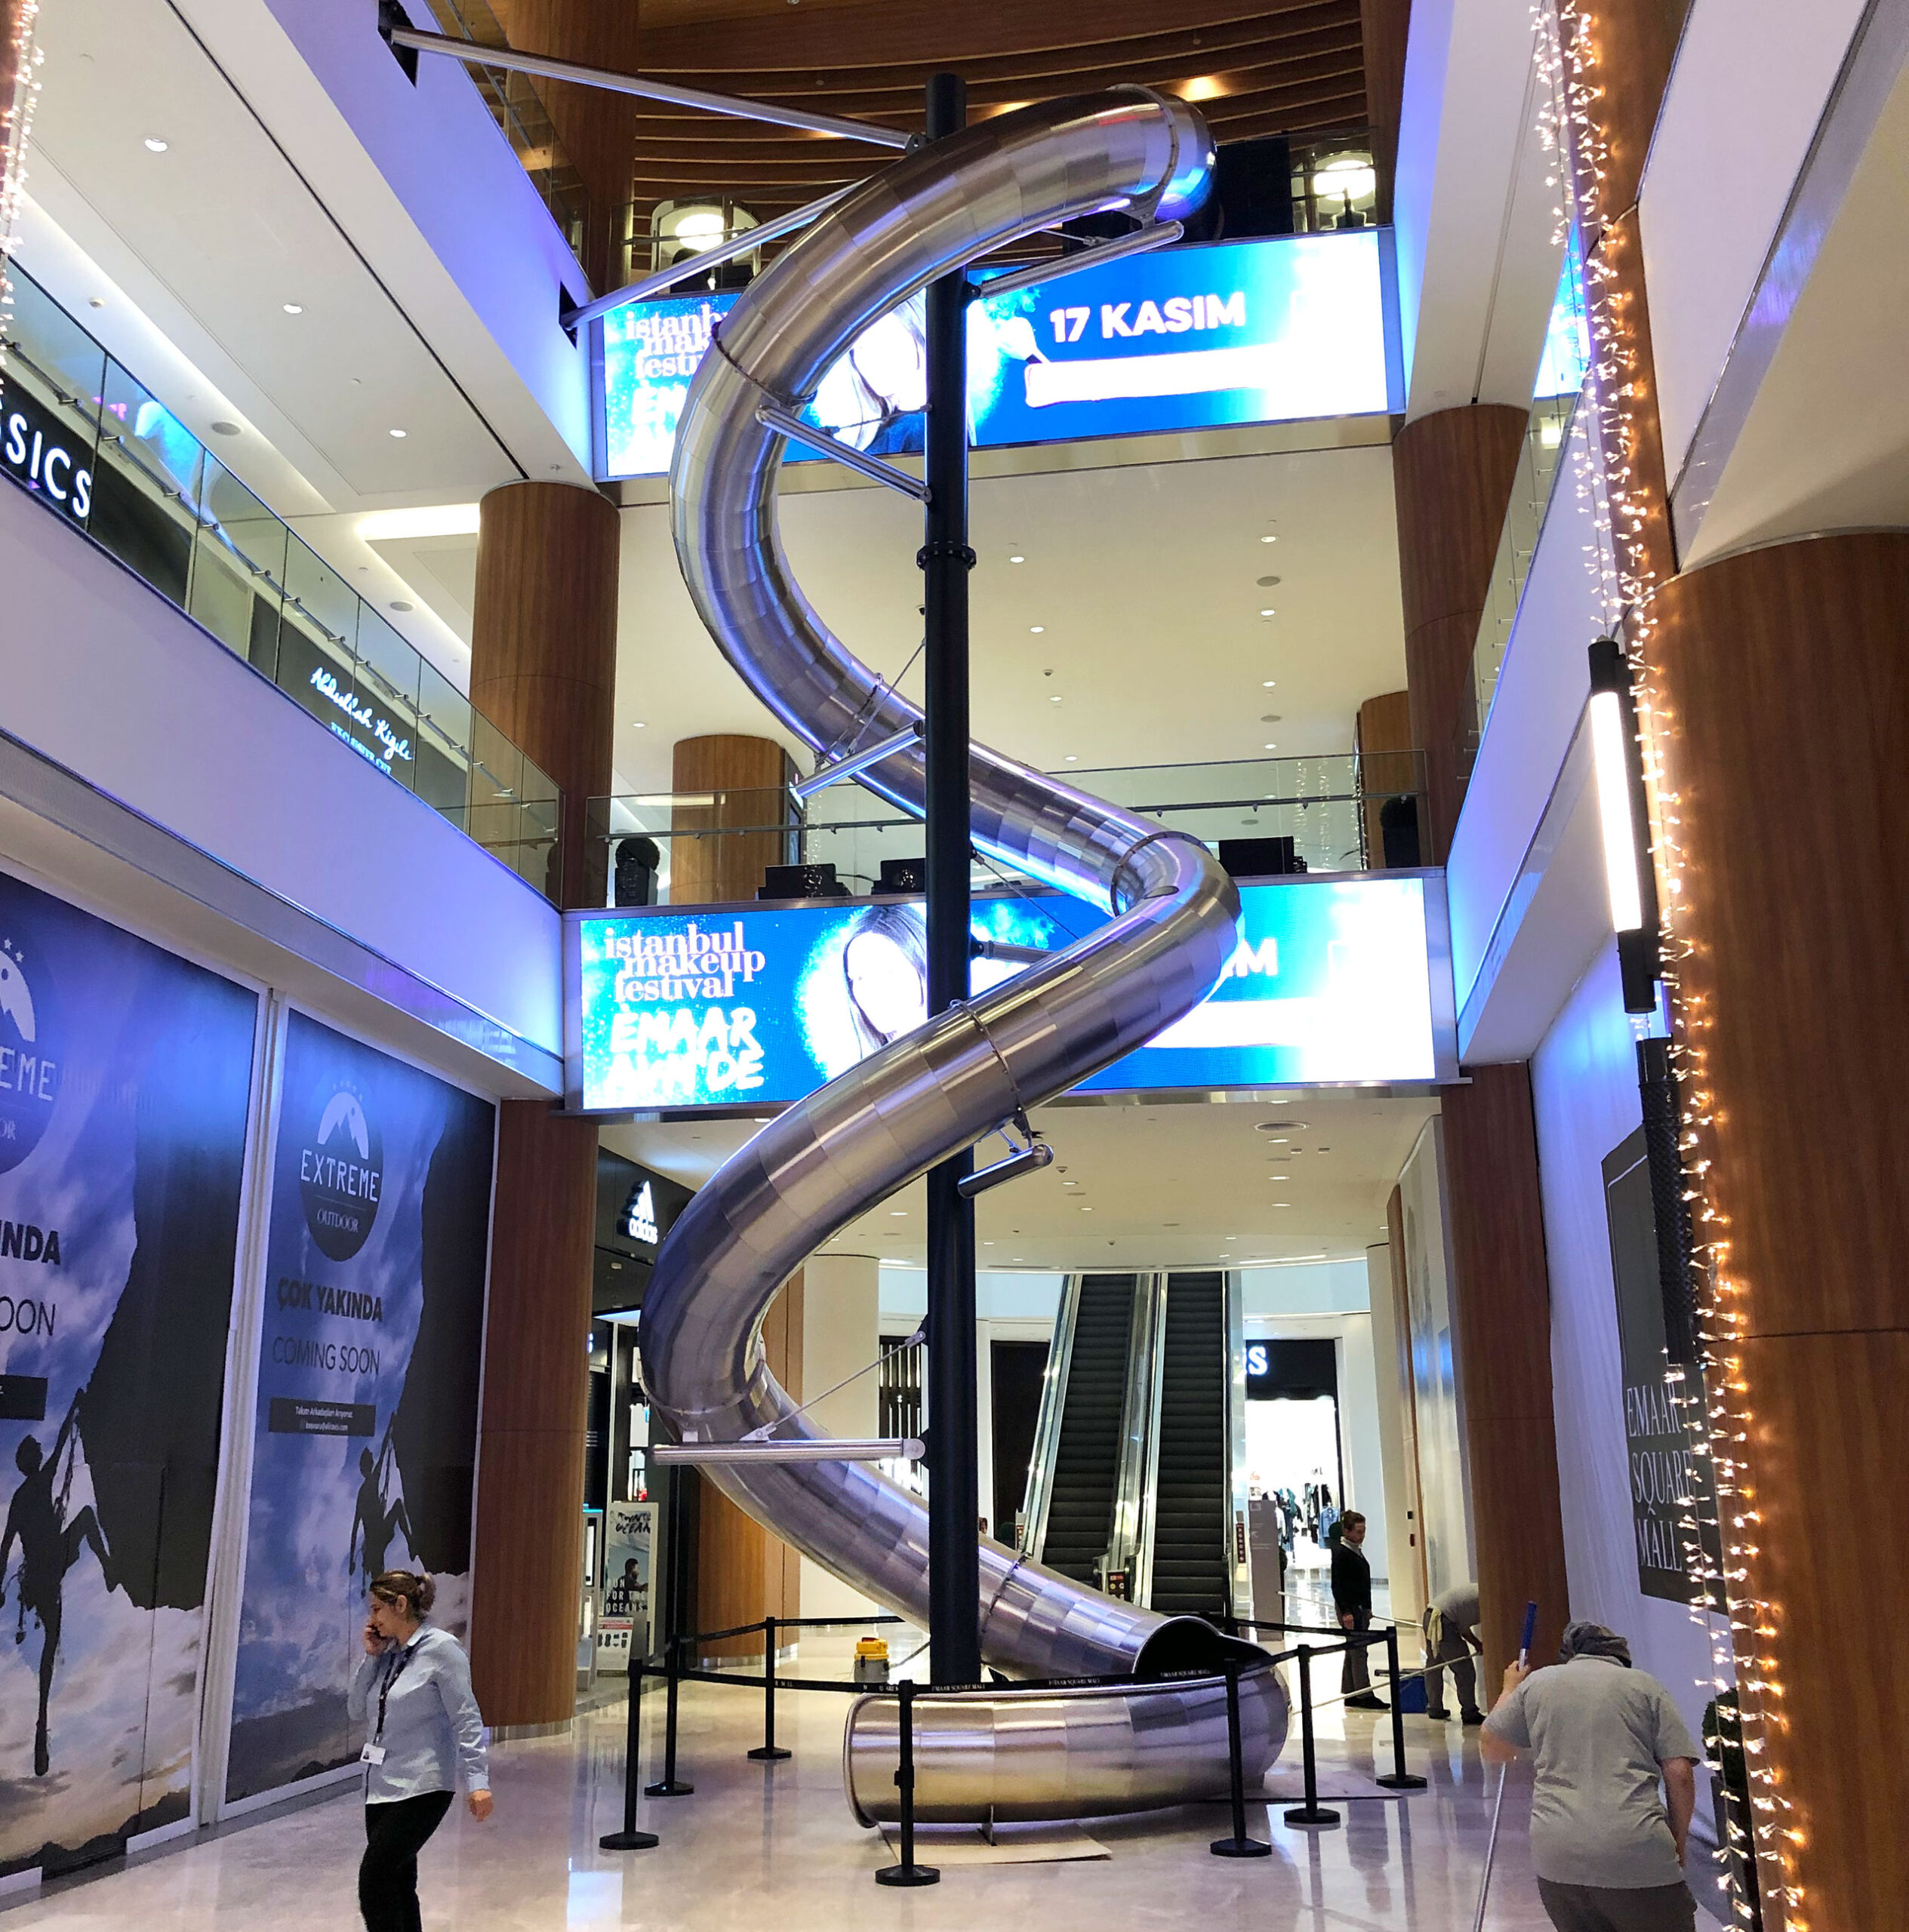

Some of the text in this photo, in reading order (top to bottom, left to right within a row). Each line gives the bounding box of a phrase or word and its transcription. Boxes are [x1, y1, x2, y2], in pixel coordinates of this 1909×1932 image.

[626, 303, 728, 340] istanb
[1050, 292, 1246, 343] 17 KASIM
[643, 323, 713, 357] mak
[0, 413, 91, 518] SICS
[604, 921, 746, 958] istanbul
[624, 942, 765, 982] makeup
[614, 966, 735, 1002] festival
[610, 1007, 762, 1054] EMAAR
[300, 1149, 379, 1201] EXTREME
[317, 1208, 359, 1233] OUTDOOR
[629, 1216, 657, 1244] adidas
[0, 1296, 55, 1336] OON
[277, 1277, 383, 1321] ÇOK YAKINDA
[272, 1336, 380, 1376] COMING SOON
[1627, 1381, 1682, 1437] EMAAR
[1632, 1450, 1693, 1515] SQUARE
[1637, 1518, 1683, 1572] MALL
[606, 1591, 624, 1601] FOR
